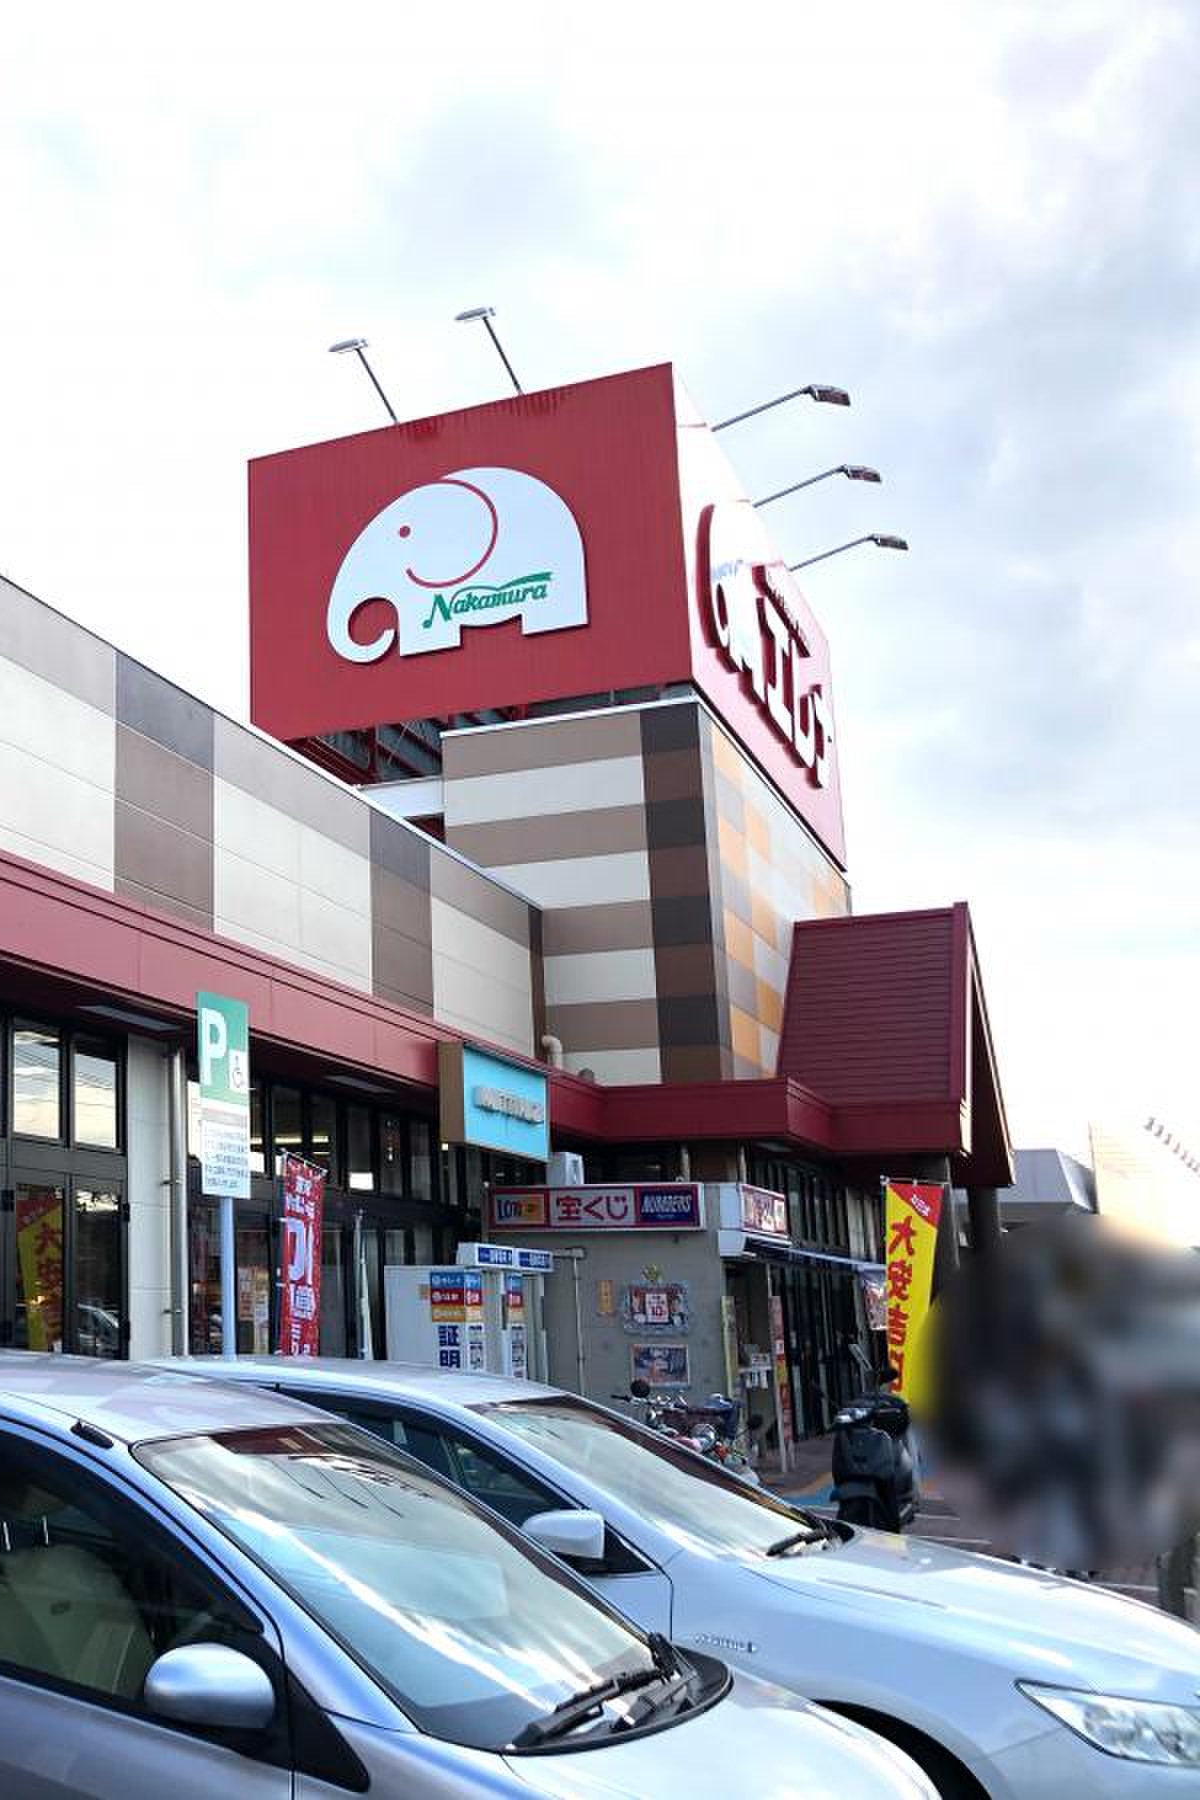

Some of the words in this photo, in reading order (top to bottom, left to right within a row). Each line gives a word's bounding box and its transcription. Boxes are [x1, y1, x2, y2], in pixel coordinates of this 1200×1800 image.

[422, 572, 553, 629] Nakamura
[201, 1008, 228, 1087] P
[557, 1194, 629, 1221] 宝くじ
[438, 1324, 461, 1369] 証明
